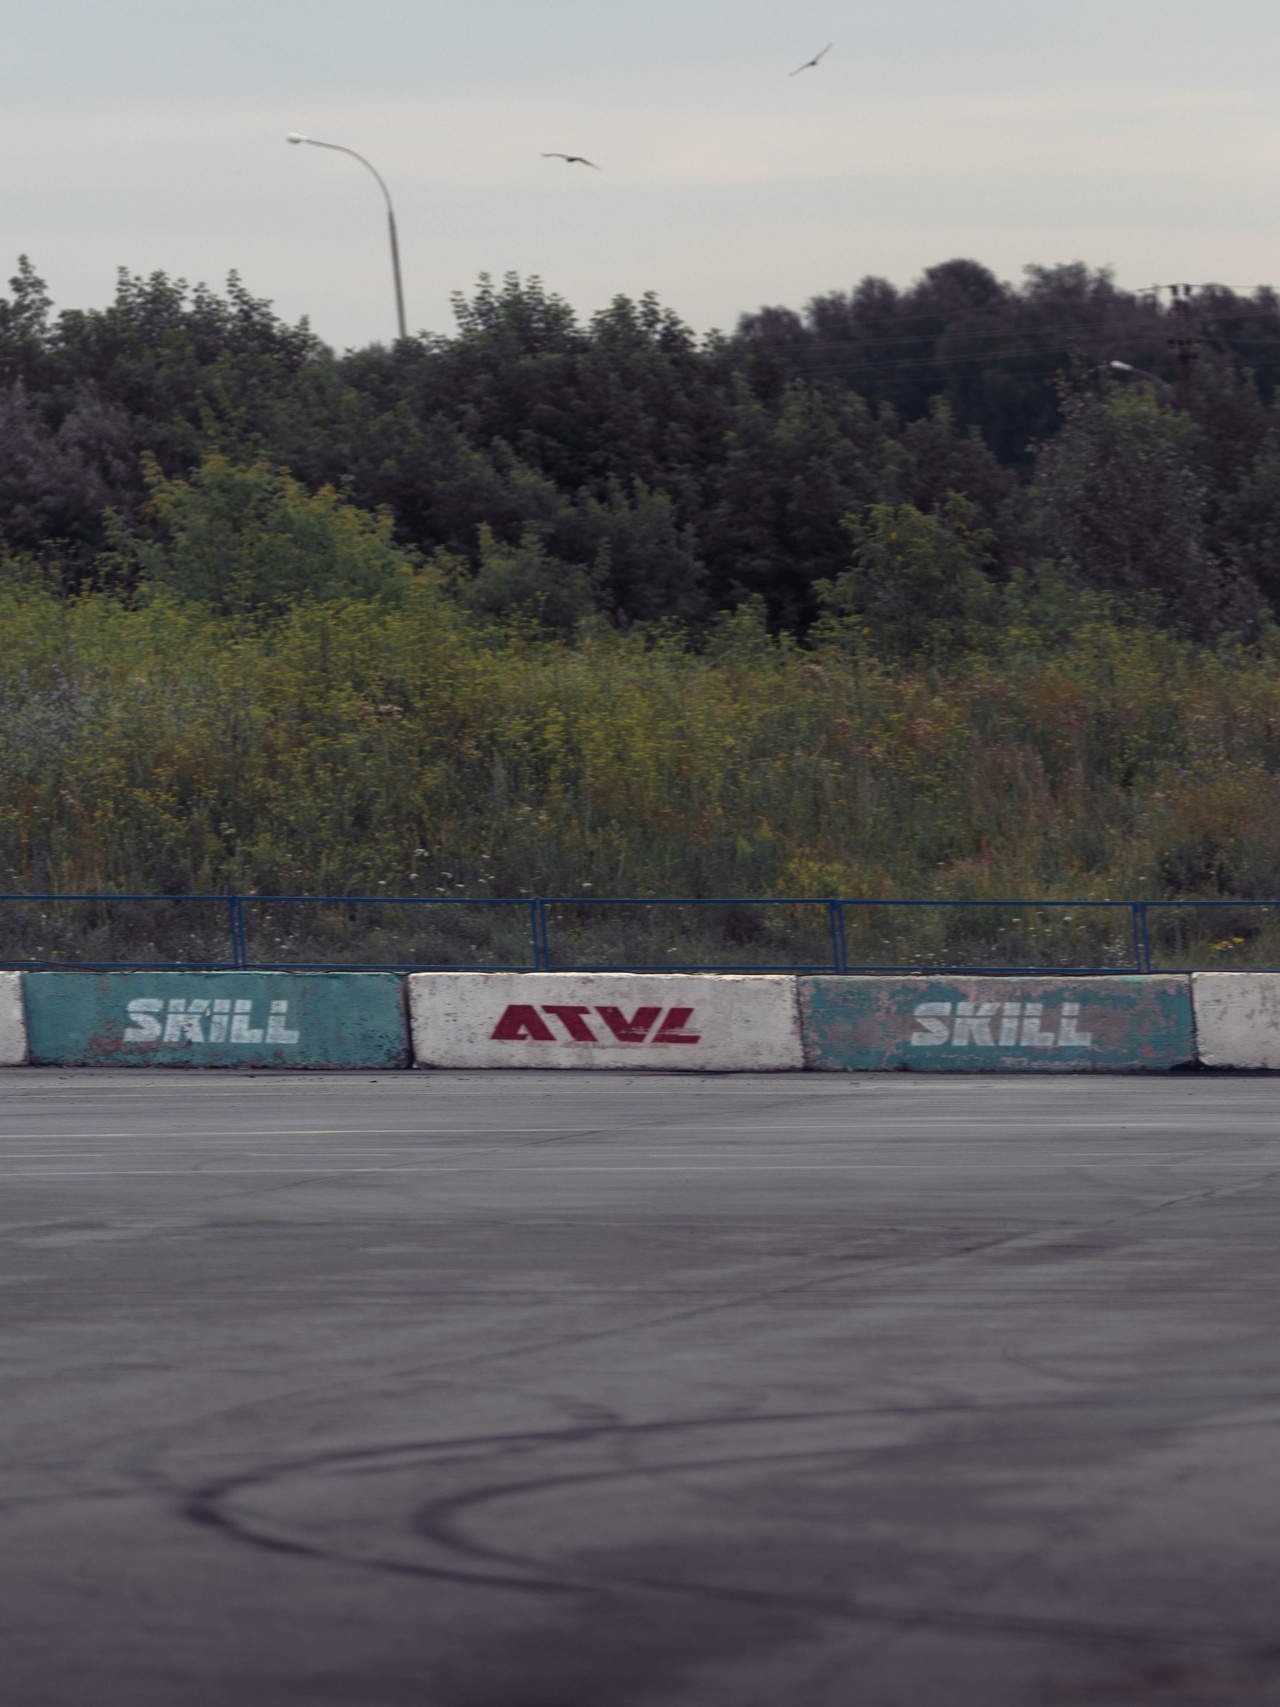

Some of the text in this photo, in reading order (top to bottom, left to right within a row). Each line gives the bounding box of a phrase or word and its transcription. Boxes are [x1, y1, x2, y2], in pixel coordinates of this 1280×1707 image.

[124, 998, 299, 1043] SKILL
[489, 1004, 702, 1044] ATVL
[911, 1001, 1092, 1046] SKILL
